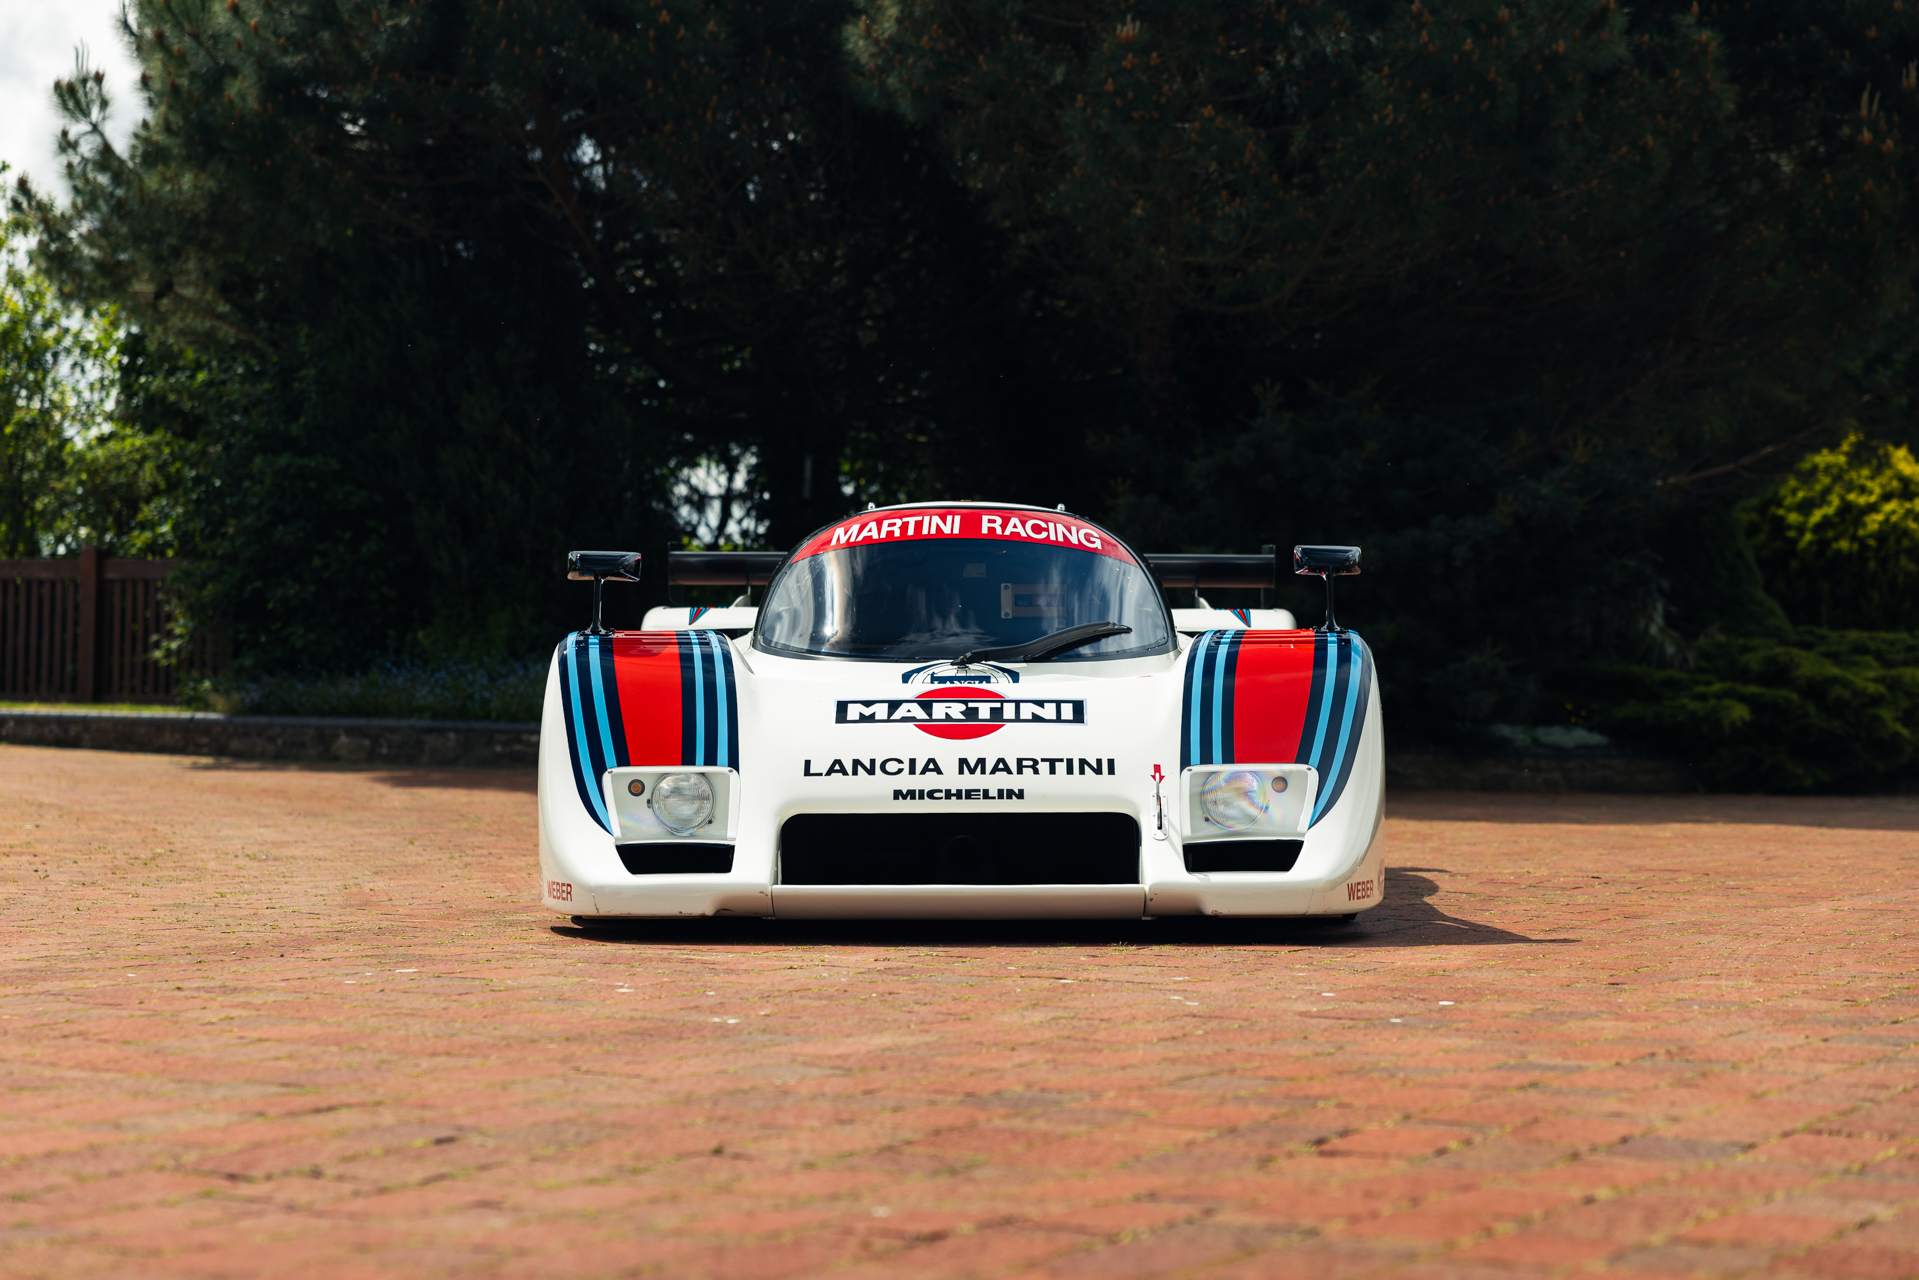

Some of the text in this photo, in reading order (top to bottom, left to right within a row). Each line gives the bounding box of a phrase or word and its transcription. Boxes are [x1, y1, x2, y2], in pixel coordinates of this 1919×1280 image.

[831, 514, 1103, 549] MARTINI RACING
[846, 702, 1073, 720] MARTINI
[803, 757, 1116, 776] LANCIA MARTINI
[893, 788, 1025, 800] MICHELIN
[546, 880, 573, 902] WEBER
[1347, 880, 1374, 901] WEBER
